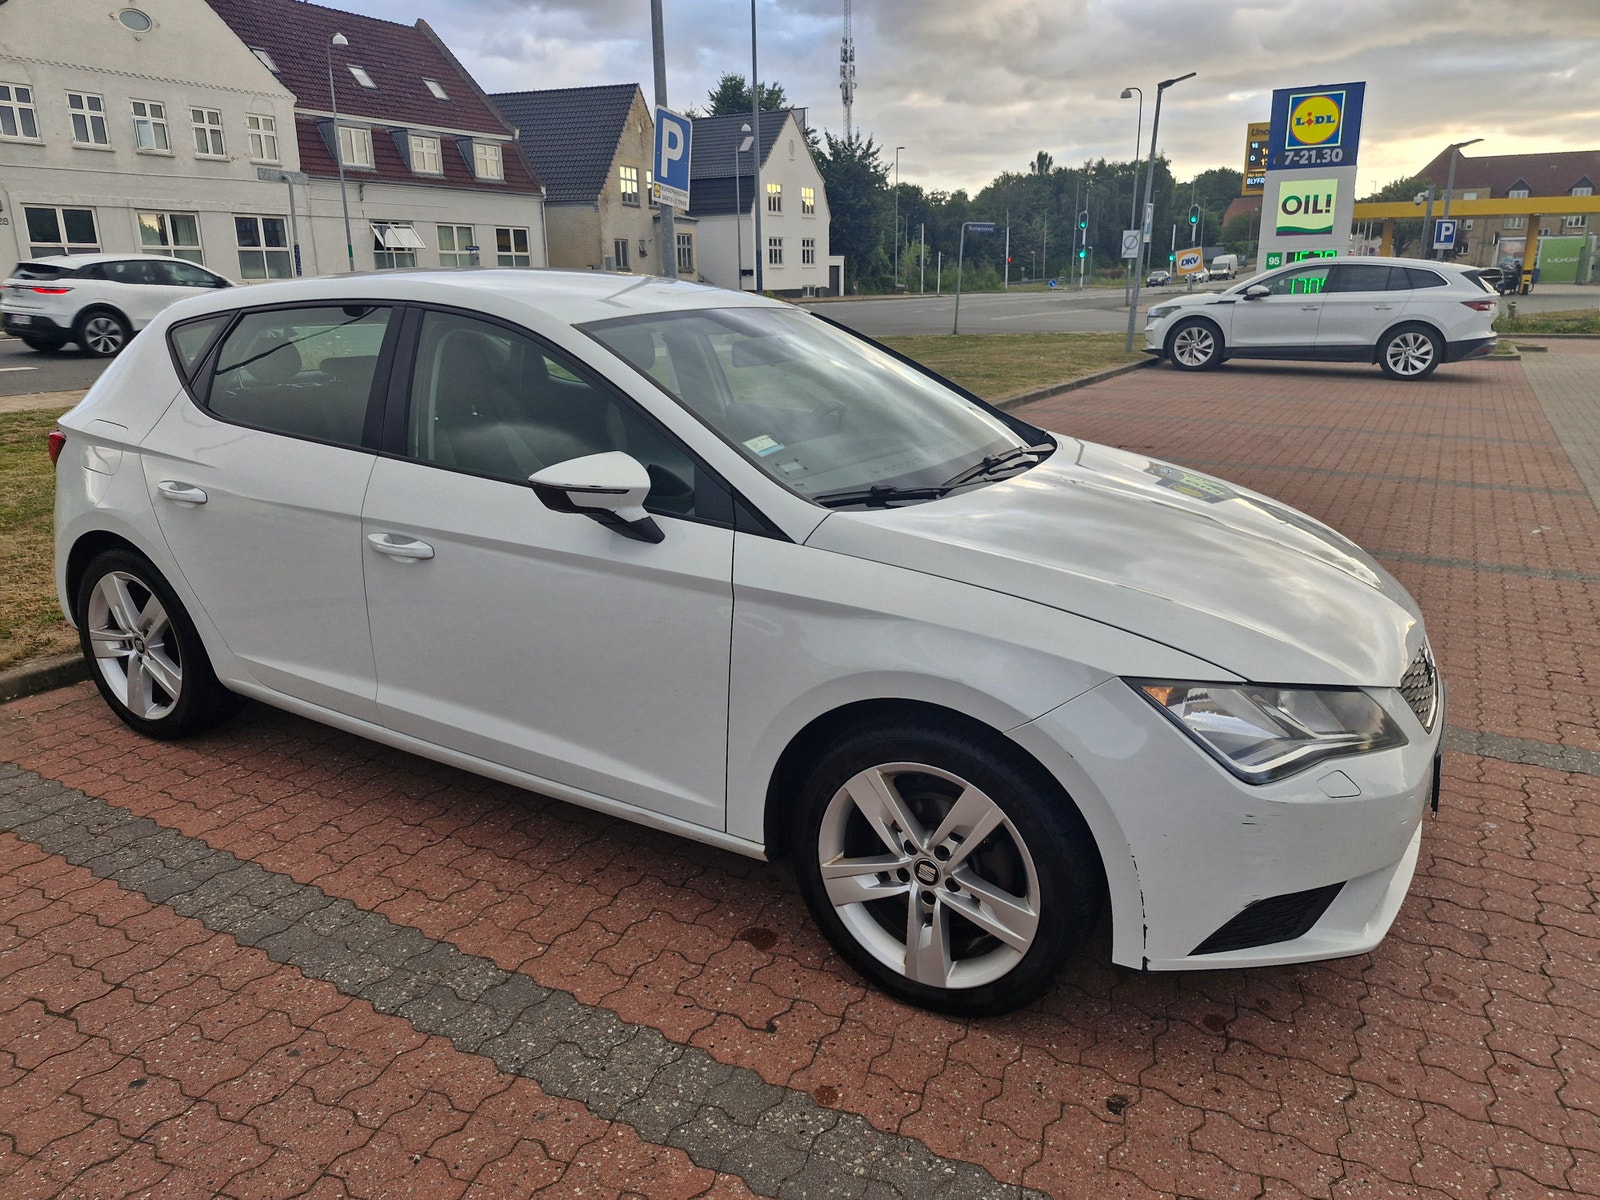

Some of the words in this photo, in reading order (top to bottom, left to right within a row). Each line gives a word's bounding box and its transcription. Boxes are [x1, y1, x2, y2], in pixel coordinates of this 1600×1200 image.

[661, 118, 684, 178] P
[1284, 148, 1343, 165] 7-21.30
[1281, 194, 1332, 215] OIL!
[1440, 223, 1454, 242] P
[1181, 256, 1199, 267] DKV
[1268, 257, 1280, 265] 95
